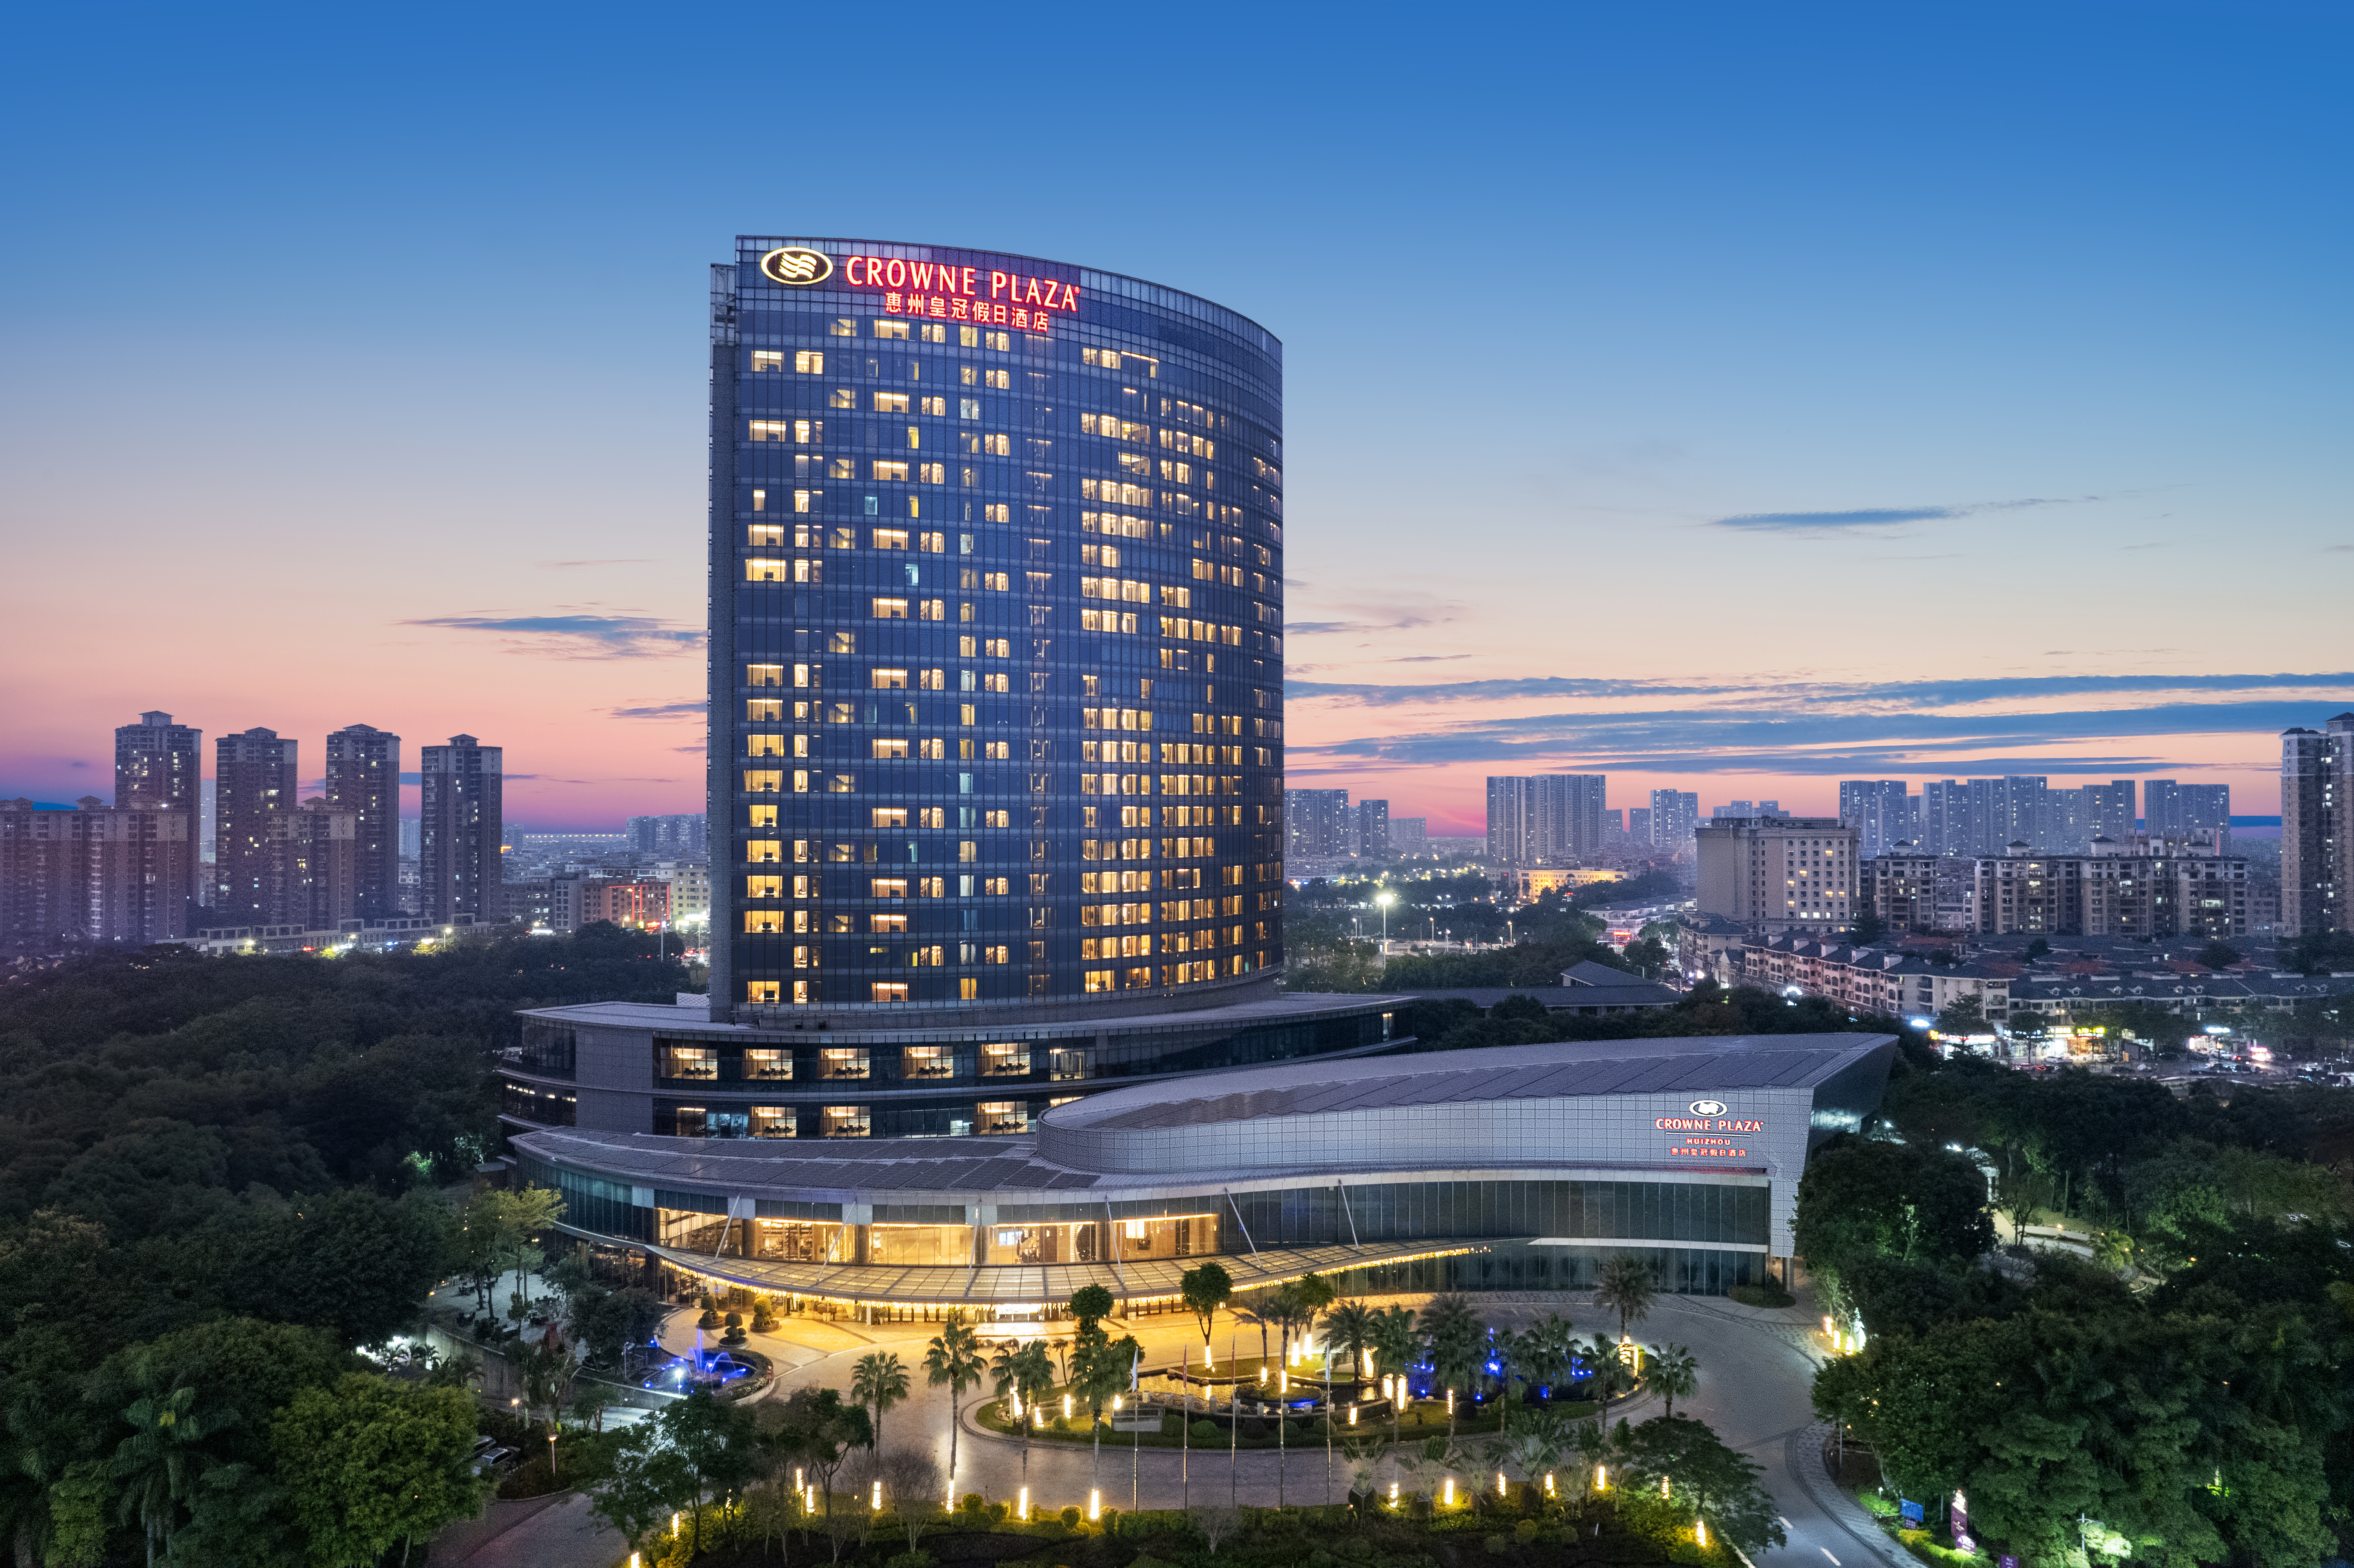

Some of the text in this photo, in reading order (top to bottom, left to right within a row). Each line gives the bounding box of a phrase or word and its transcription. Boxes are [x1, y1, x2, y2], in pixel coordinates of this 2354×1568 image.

[846, 255, 976, 295] CROWNE
[885, 291, 1049, 332] 惠州皇冠假日酒店
[1655, 1118, 1762, 1132] CROWNE PLAZA
[1671, 1147, 1747, 1157] 惠州皇冠假日酒店
